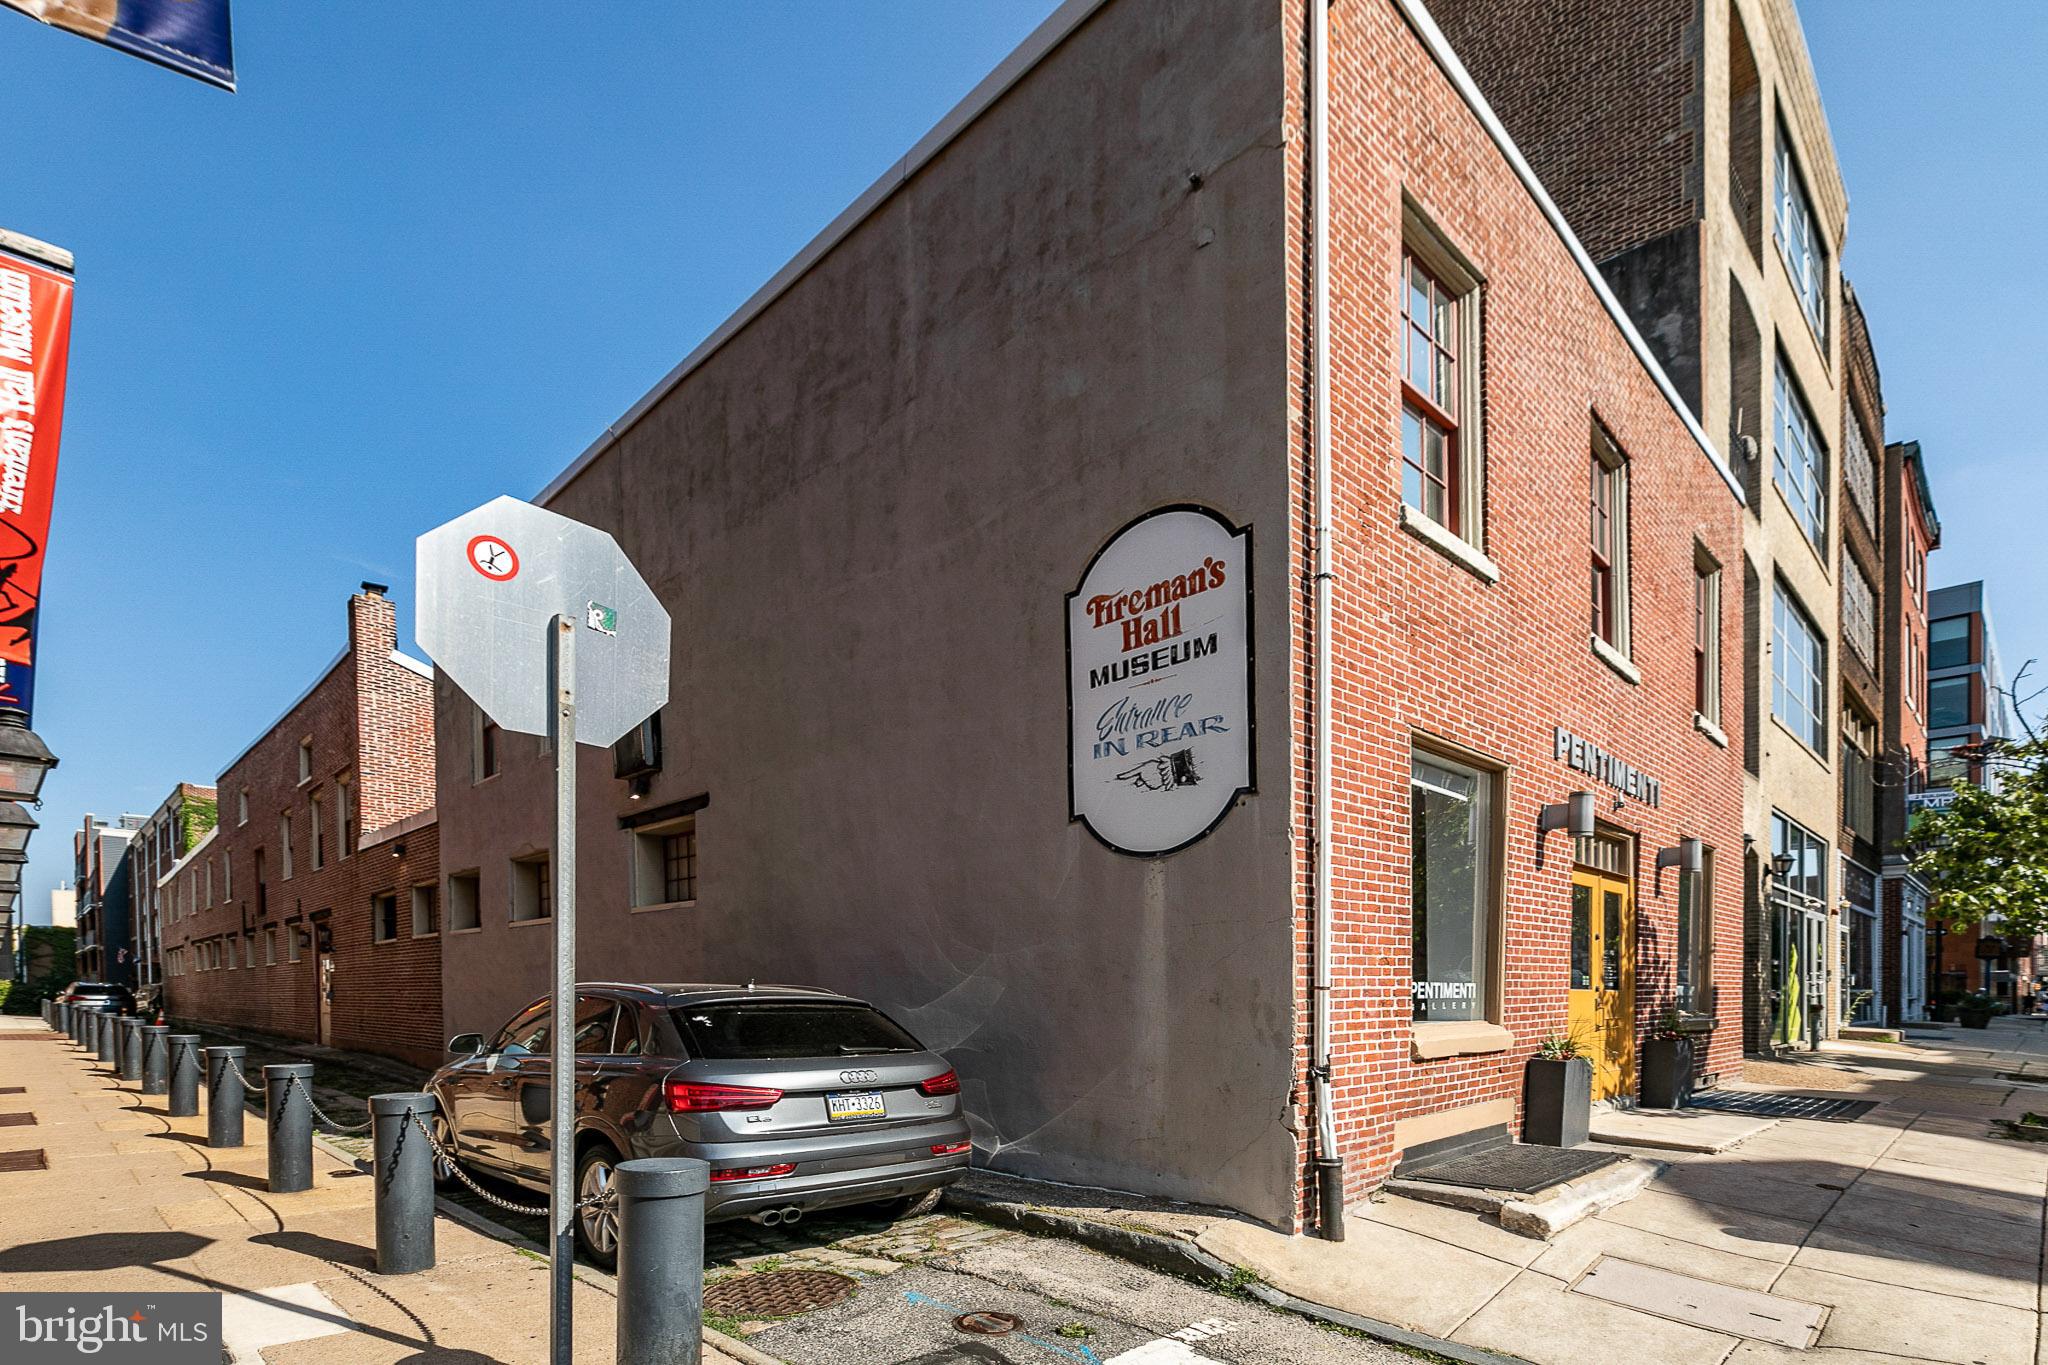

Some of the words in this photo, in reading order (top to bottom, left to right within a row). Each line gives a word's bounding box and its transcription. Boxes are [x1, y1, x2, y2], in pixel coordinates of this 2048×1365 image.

[1087, 557, 1226, 629] Fireman's
[1121, 602, 1183, 652] Hall
[1090, 632, 1218, 689] MUSEUM
[1093, 737, 1129, 759] IN
[1136, 714, 1231, 750] REAR
[1096, 693, 1193, 741] Entrance
[1554, 726, 1660, 809] PENTIMENTI
[1412, 981, 1476, 999] PENTIMENTI
